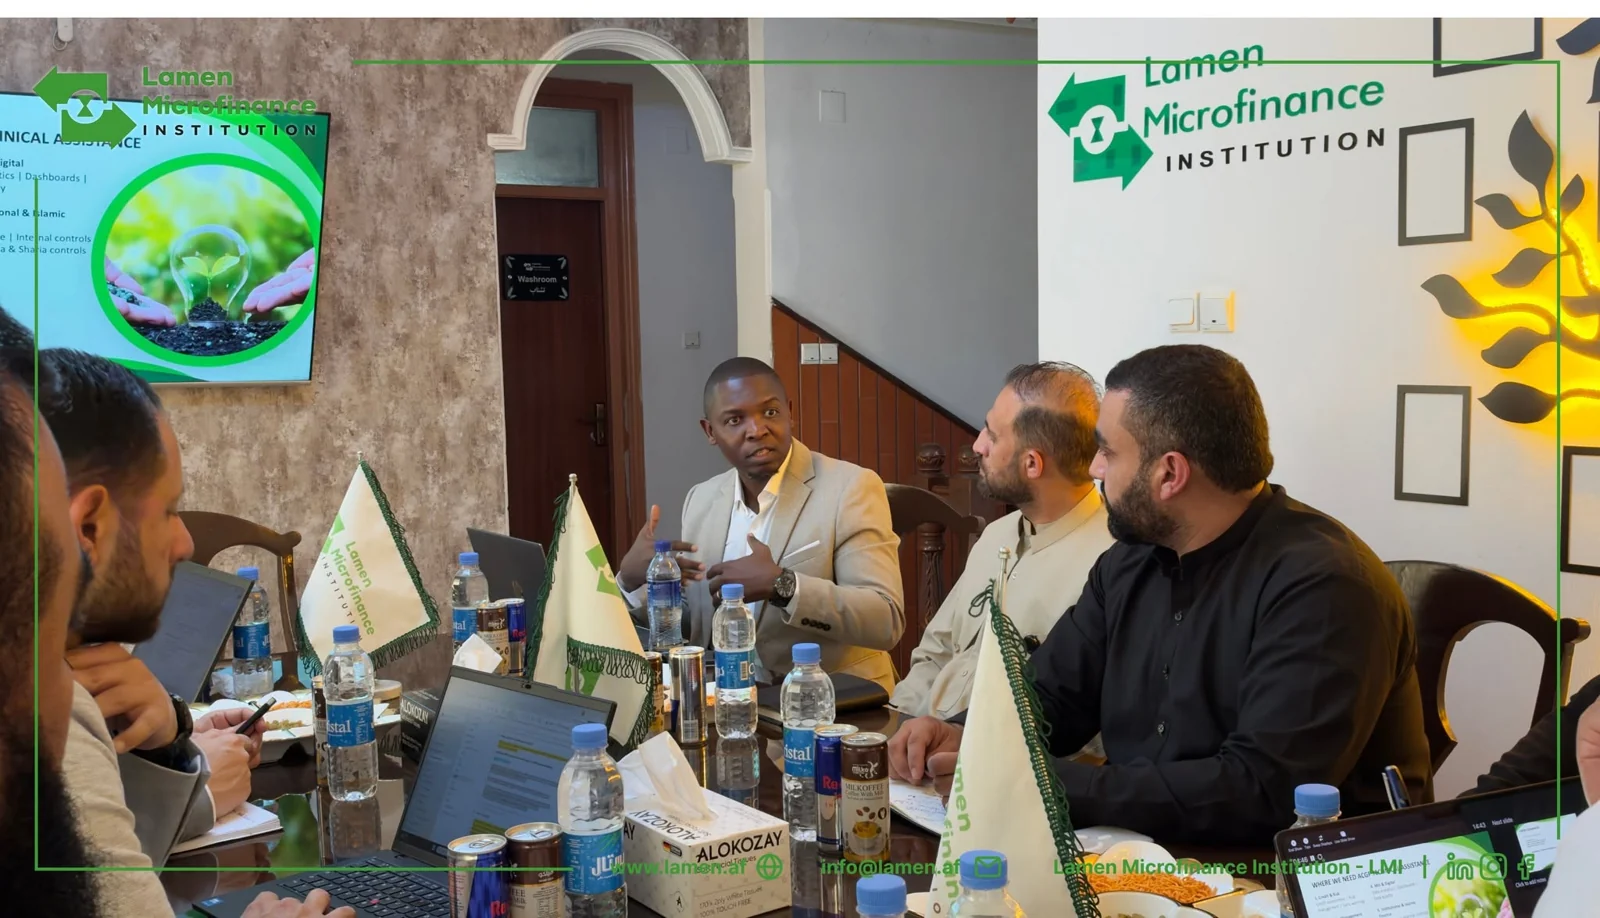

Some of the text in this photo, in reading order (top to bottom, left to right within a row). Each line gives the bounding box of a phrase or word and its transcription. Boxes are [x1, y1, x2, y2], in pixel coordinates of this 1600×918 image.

[1144, 44, 1265, 88] Lamen
[1142, 80, 1385, 138] Microfinance
[1165, 127, 1386, 172] INSTITUTION
[25, 172, 81, 182] Dashboards
[16, 233, 52, 242] Intenal
[54, 234, 92, 243] controls
[18, 245, 47, 253] Shaia
[49, 246, 87, 255] controls
[517, 275, 557, 283] Washroom
[345, 540, 373, 589] Lamen
[321, 556, 363, 641] INSTITUTI
[330, 547, 376, 636] Microfinance
[695, 830, 783, 863] ALOKOZAY
[1311, 879, 1331, 889] WHERE
[1332, 877, 1341, 885] WE
[1342, 874, 1357, 883] NEED
